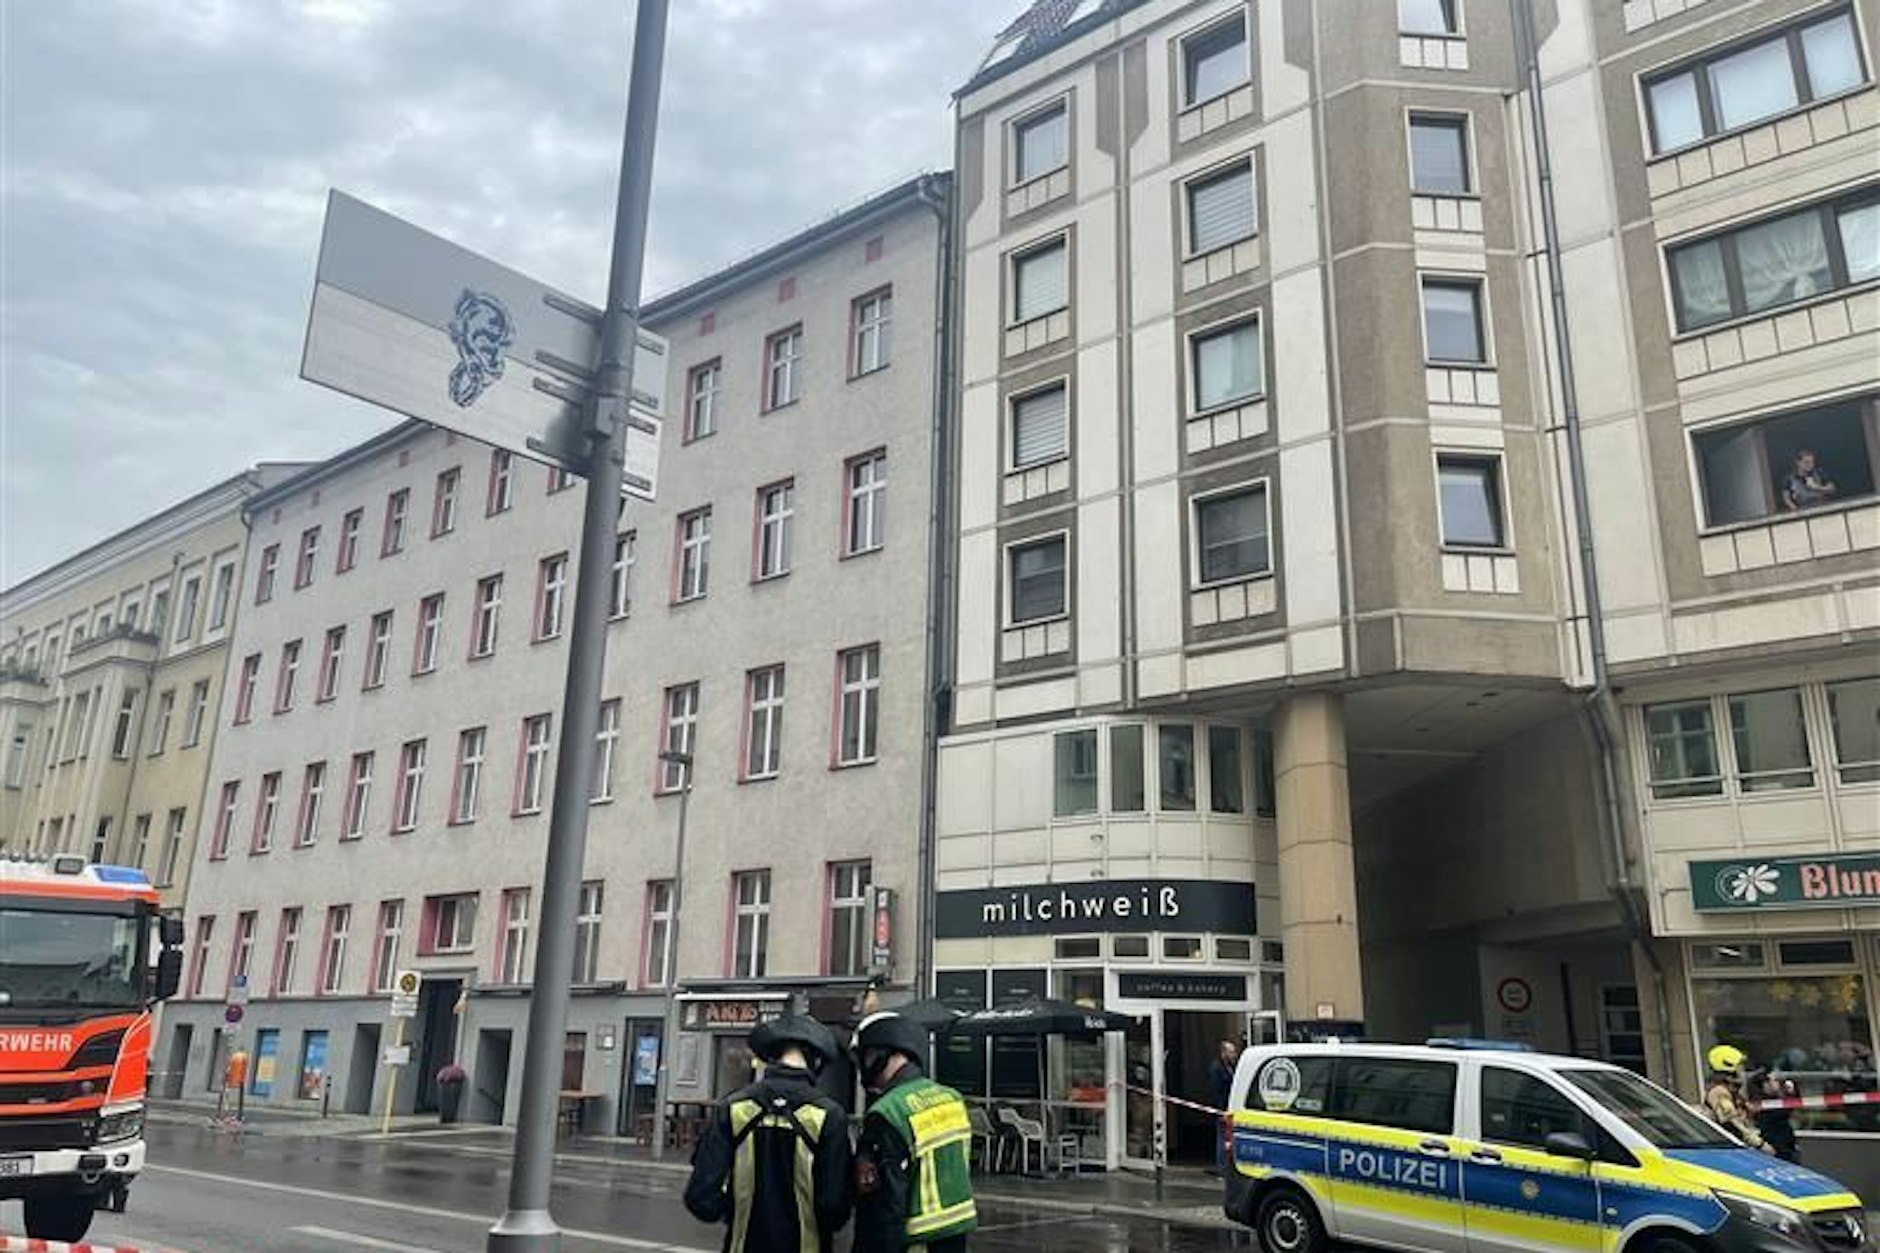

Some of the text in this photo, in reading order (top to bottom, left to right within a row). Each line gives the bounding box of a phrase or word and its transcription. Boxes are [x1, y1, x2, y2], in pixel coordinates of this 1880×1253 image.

[983, 886, 1179, 922] milchweiß
[0, 1033, 73, 1052] RWEHR
[1339, 1148, 1447, 1189] POLIZEI
